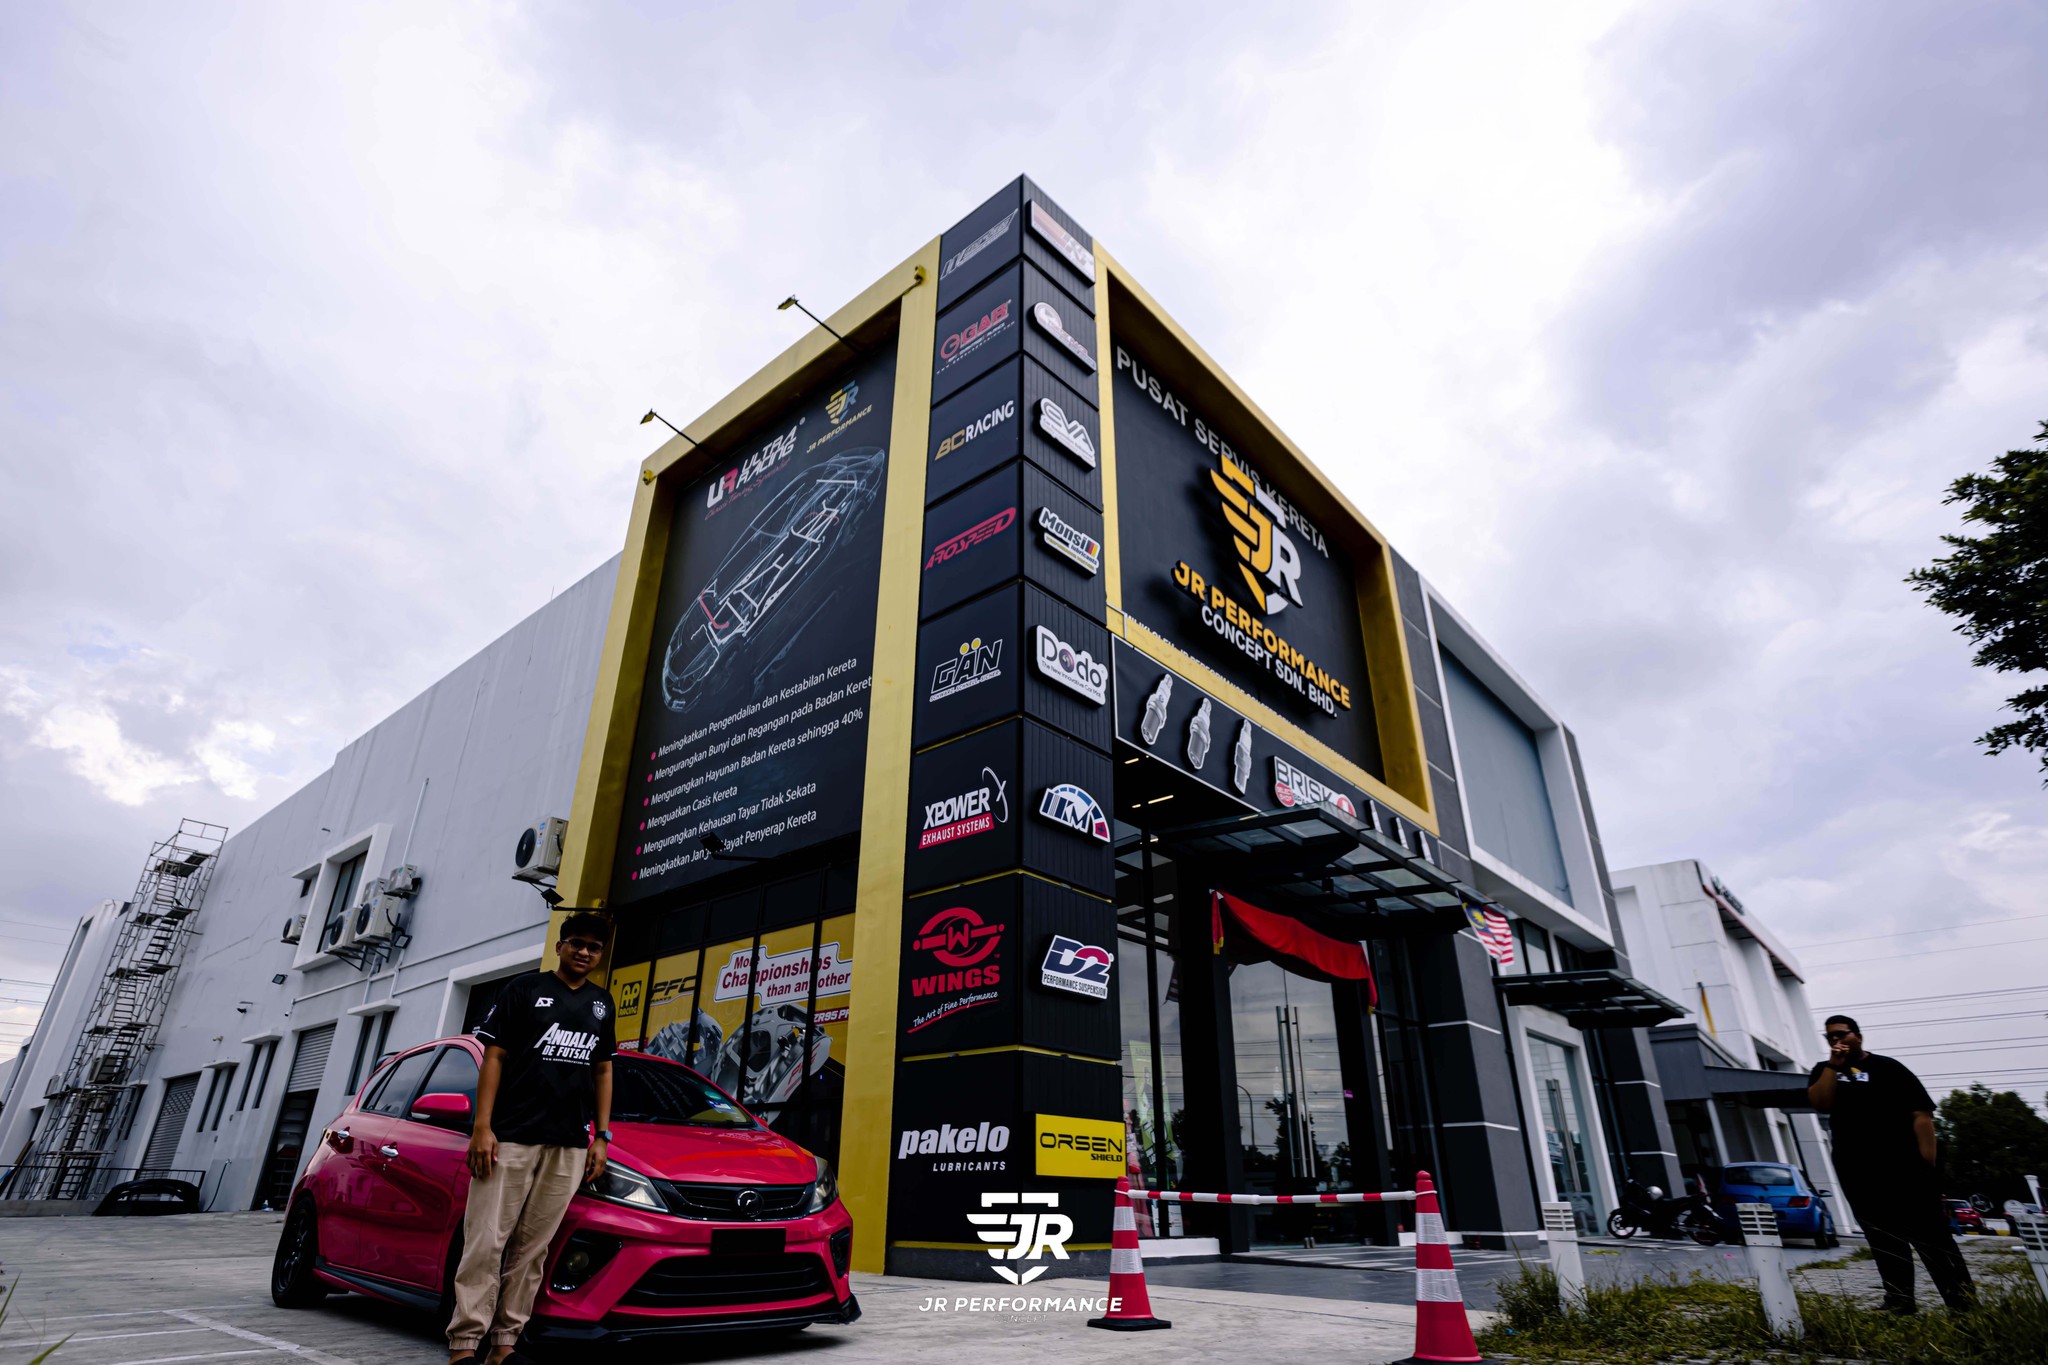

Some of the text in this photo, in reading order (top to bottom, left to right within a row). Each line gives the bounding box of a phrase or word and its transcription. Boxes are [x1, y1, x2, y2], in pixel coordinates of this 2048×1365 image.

[1116, 345, 1189, 426] PUSAT
[817, 404, 873, 446] PERFORMANCE
[736, 443, 795, 489] RACING
[742, 425, 798, 472] ULTRA
[1174, 561, 1206, 600] JR
[1211, 587, 1351, 709] PERFORMANCE
[1041, 633, 1102, 688] Dodo
[1202, 605, 1273, 670] CONCEPT
[1275, 656, 1306, 695] SDN.
[1308, 684, 1337, 717] BHD.
[654, 676, 873, 781] Mengurangkan Bunyi dan Regangan pada Badan Keret
[657, 657, 857, 758] Meningkatkan Pengendalian dan Kestabilan Kereta
[650, 706, 864, 806] Mengurangkan Hayunan Badan Kereta sehingga 40%
[642, 781, 817, 855] Mengurangkan Kehausan Tayar Tidak Sekata
[647, 784, 738, 830] Menguatkan Casis Kereta
[923, 786, 991, 830] XPOWER
[638, 848, 690, 880] Meningkatkan
[745, 822, 785, 845] Penyerap
[786, 809, 817, 832] Kereta
[922, 815, 991, 846] EXHAUST SYSTEMS
[722, 955, 832, 990] Chapionshs
[911, 965, 1001, 997] WINGS
[1043, 936, 1109, 984] D2
[766, 983, 791, 998] than
[817, 972, 851, 989] other
[1043, 973, 1107, 997] PERFORMANCE SUSPENSION
[913, 990, 999, 1028] The Art of Fine Performance
[541, 1044, 556, 1056] DE
[556, 1046, 591, 1061] FUTSAL
[898, 1121, 1010, 1160] pakelo
[1040, 1132, 1123, 1153] ORSEN
[1091, 1153, 1123, 1162] SHIELD
[932, 1160, 1007, 1172] LUBRICANTS
